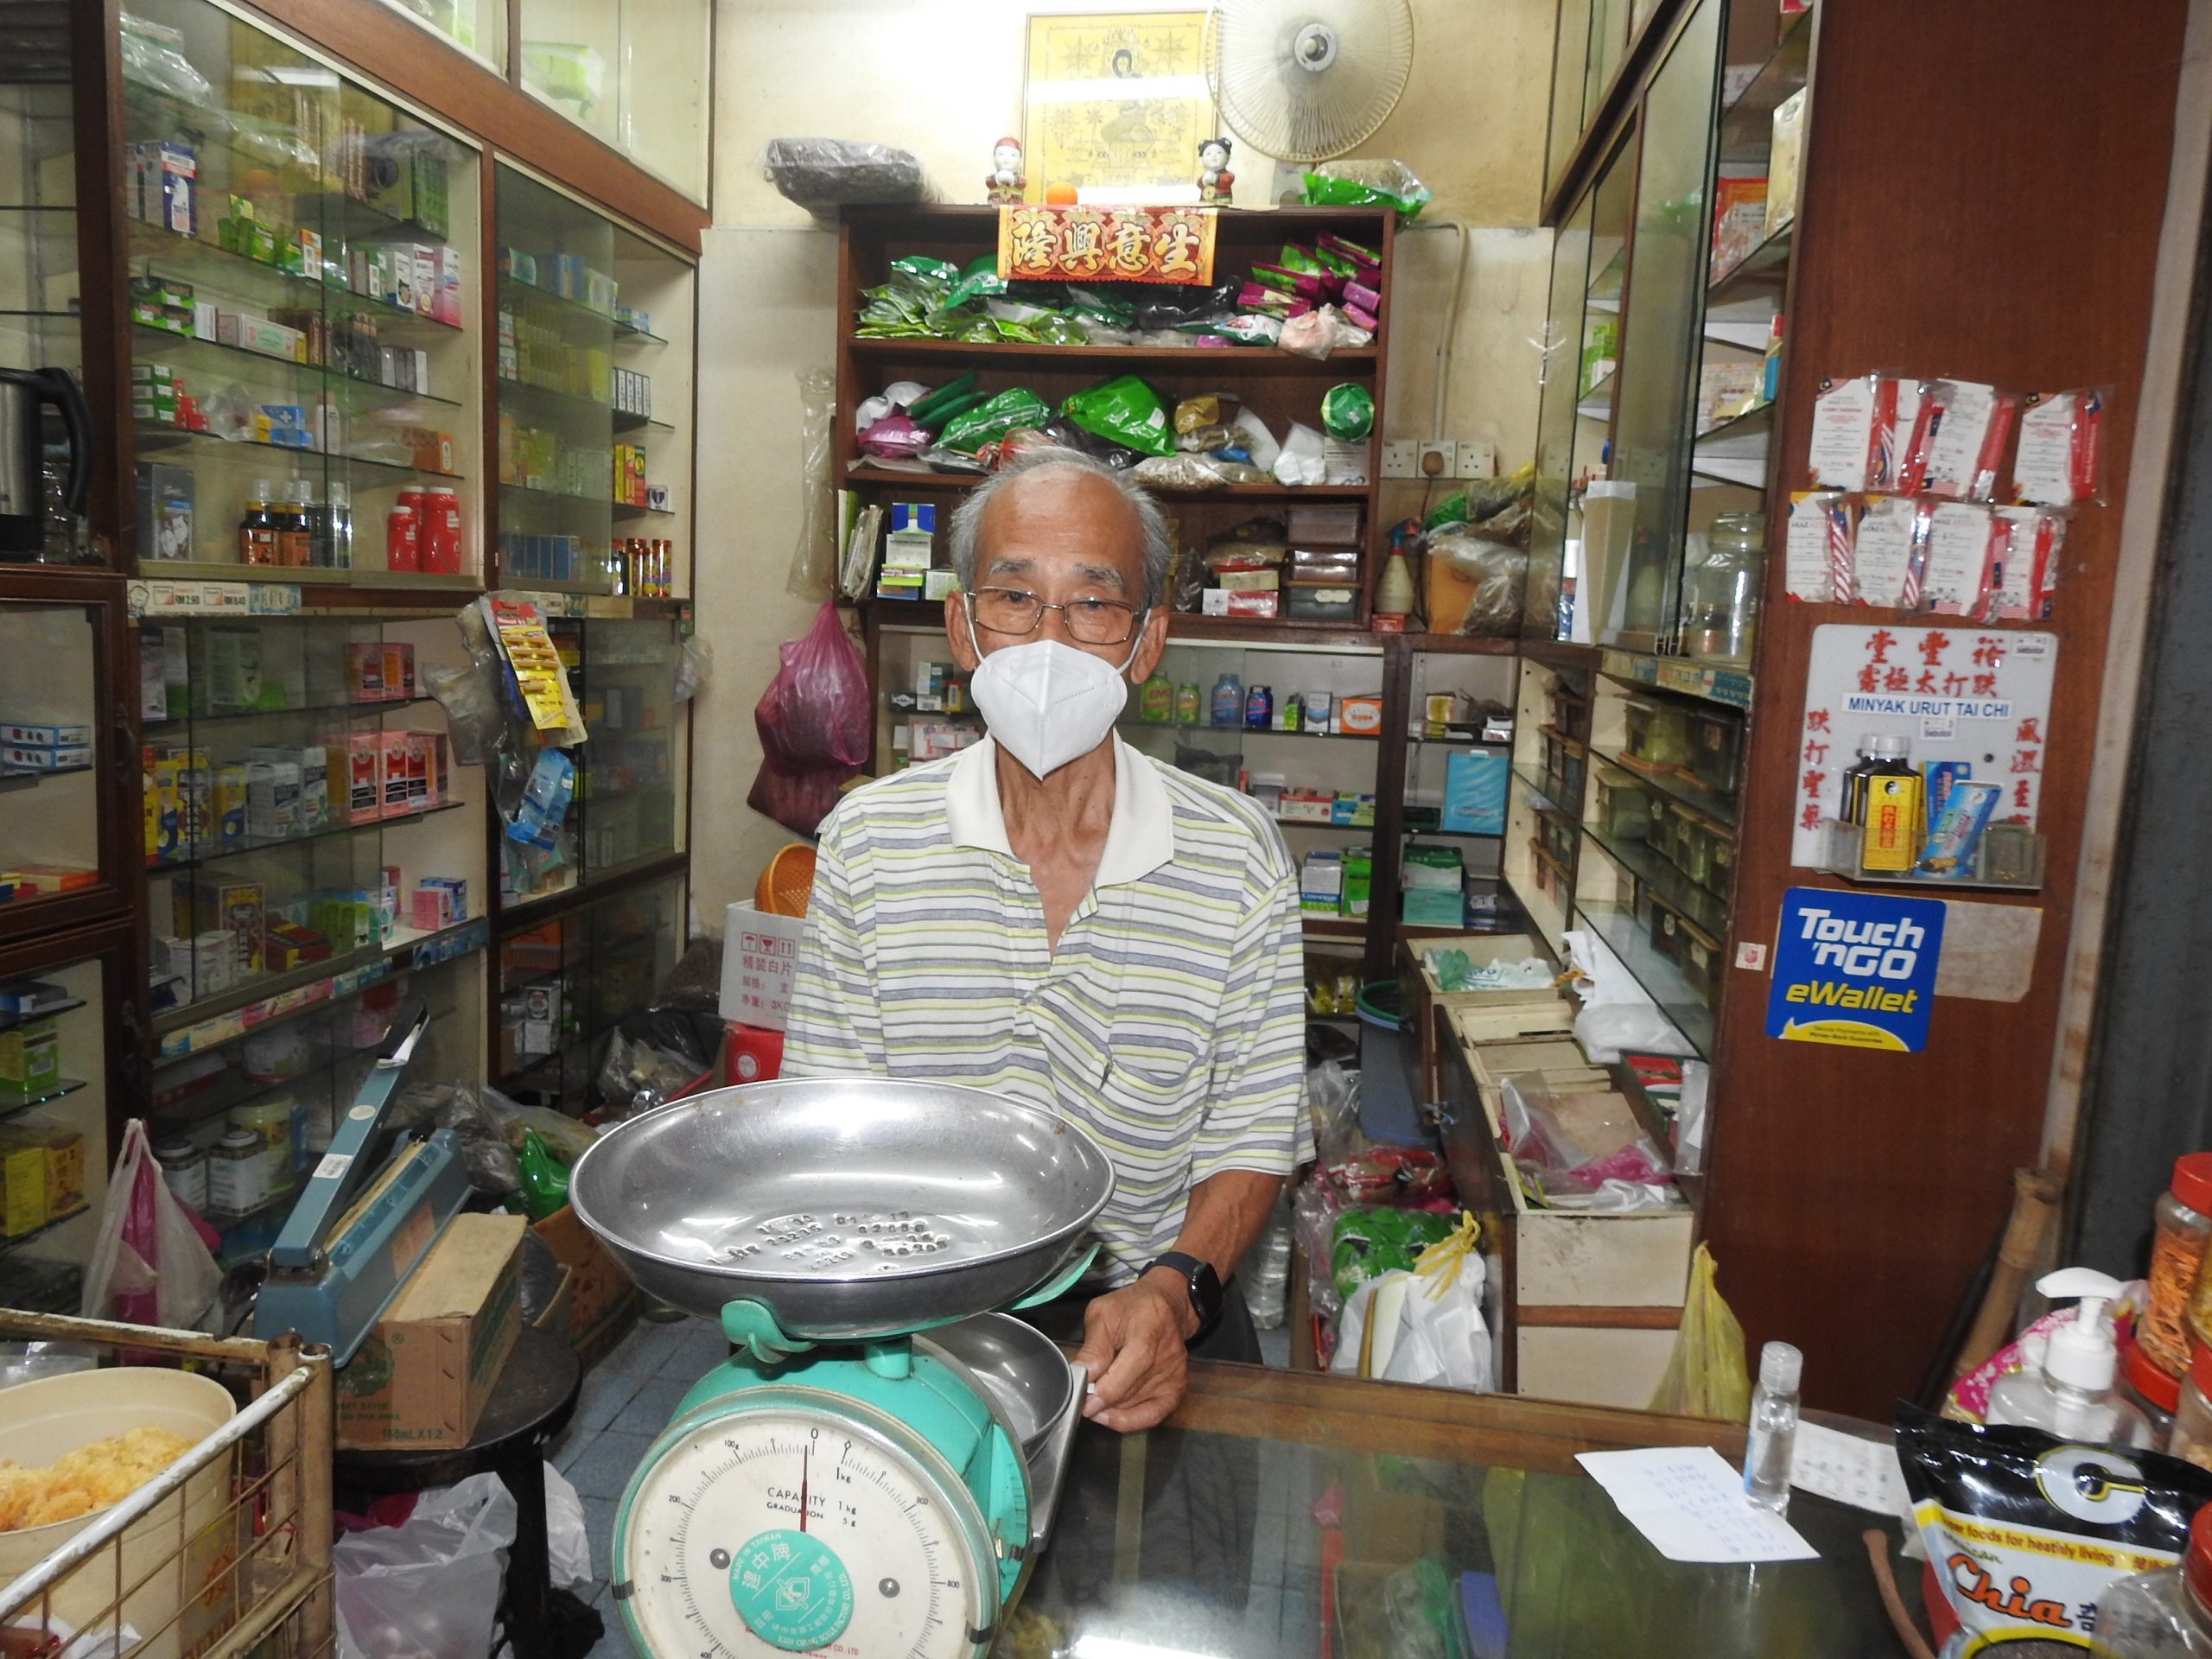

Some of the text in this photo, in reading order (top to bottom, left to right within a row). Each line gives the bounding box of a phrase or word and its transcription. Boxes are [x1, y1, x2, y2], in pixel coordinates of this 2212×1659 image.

[1848, 697, 2009, 717] MINYAK URUT TAI CHI
[1797, 907, 1925, 949] Touch
[1785, 981, 1918, 1014] eWallet
[810, 1428, 819, 1440] 0
[669, 1494, 680, 1503] 200
[767, 1487, 826, 1507] CAPAITY
[766, 1502, 823, 1519] GRADUAION
[733, 1559, 745, 1580] MADE
[752, 1533, 782, 1548] TAIWAN
[1948, 1553, 2073, 1627] Chia
